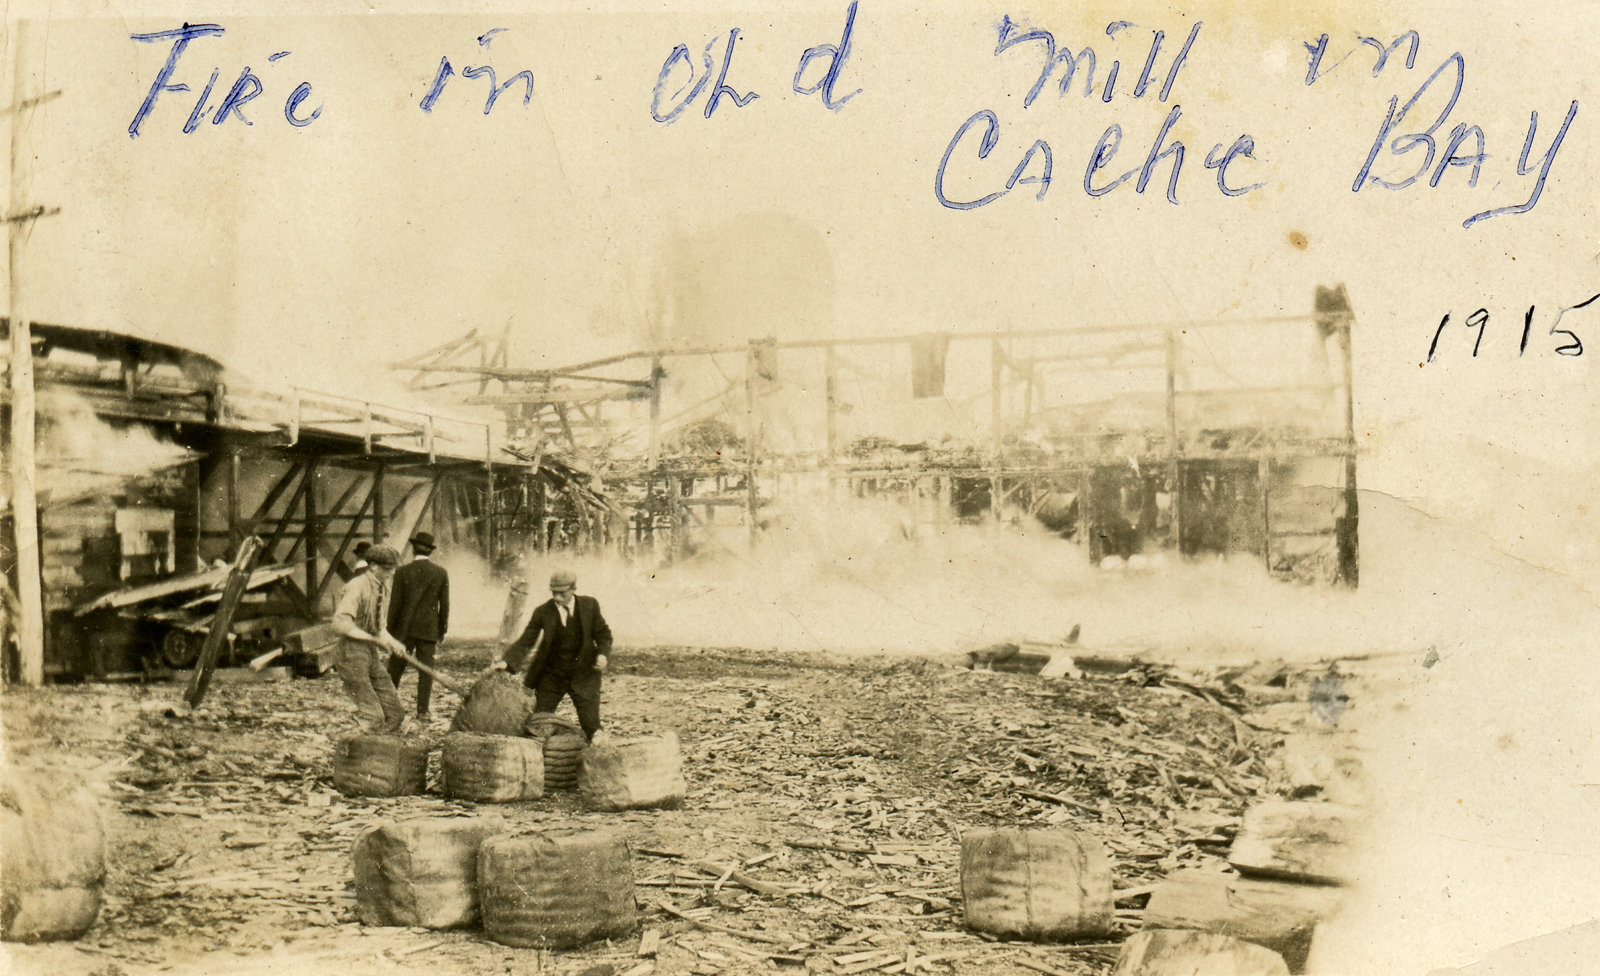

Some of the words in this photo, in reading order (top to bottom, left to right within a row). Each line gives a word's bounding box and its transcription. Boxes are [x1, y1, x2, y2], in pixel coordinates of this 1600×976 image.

[421, 30, 534, 115] in
[1304, 31, 1420, 85] in
[1427, 293, 1600, 362] 1915
